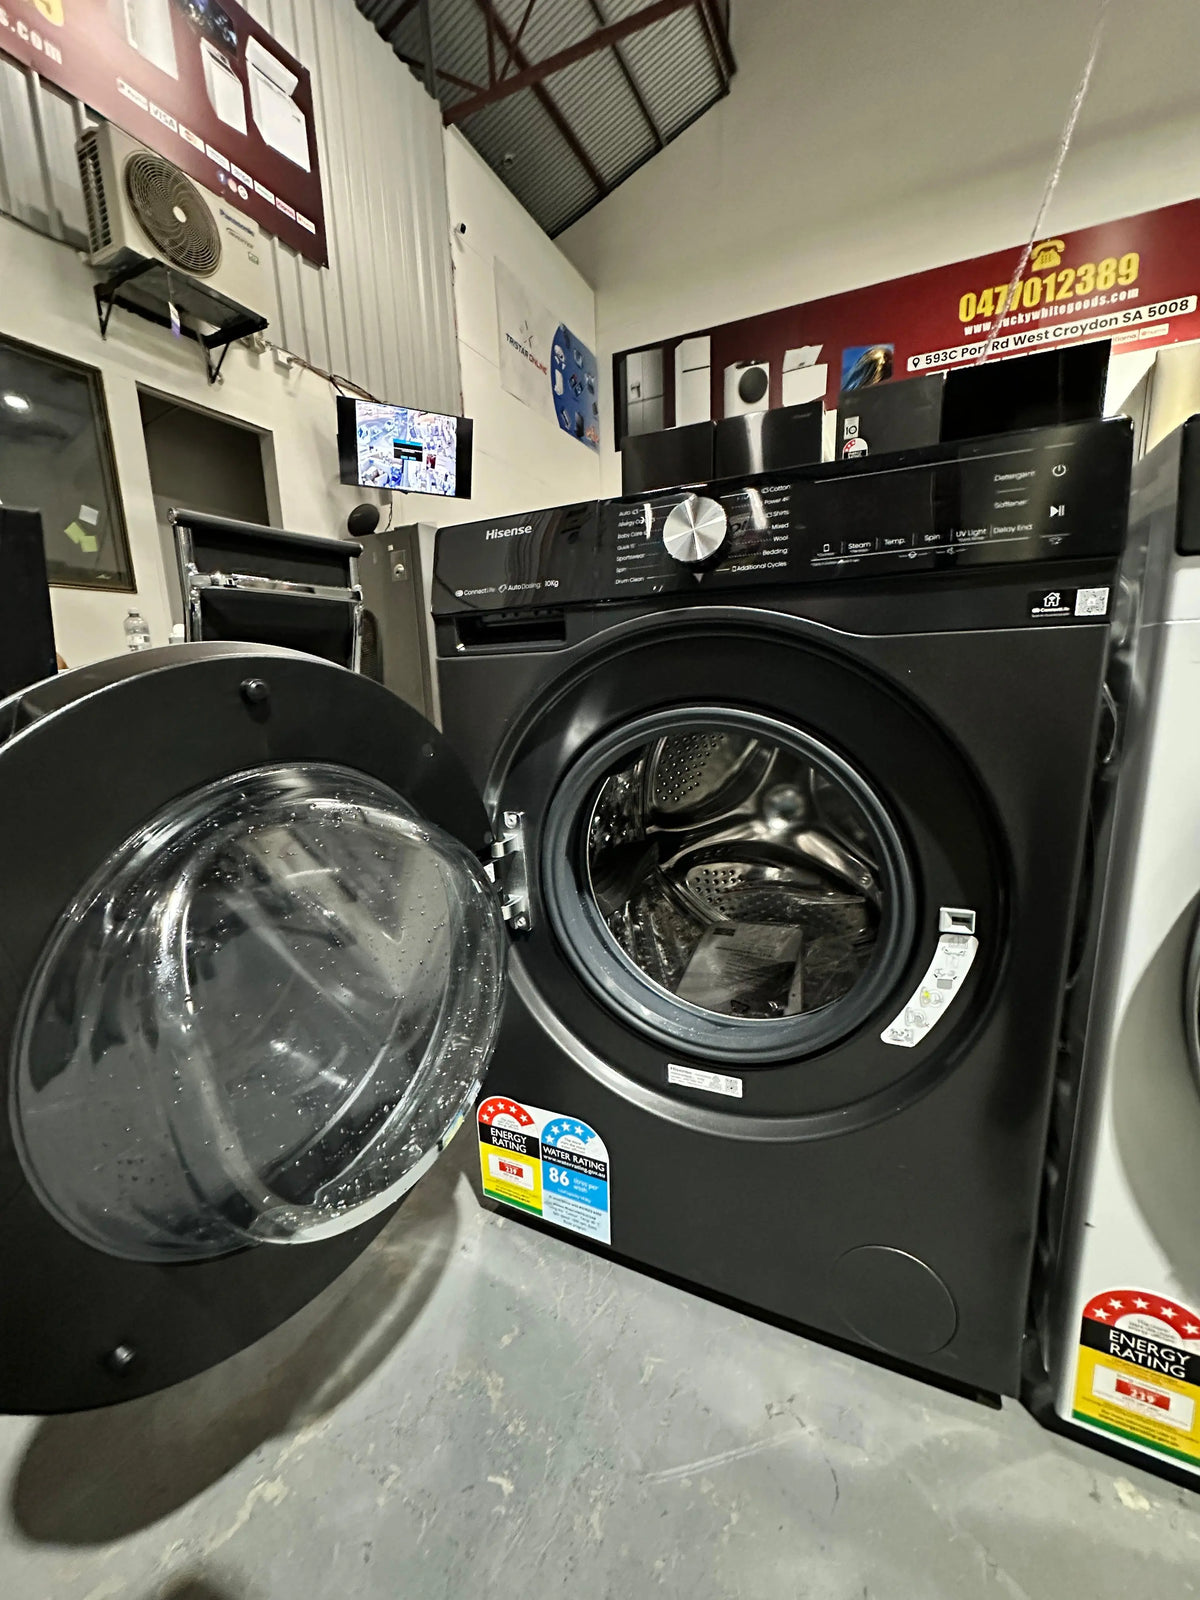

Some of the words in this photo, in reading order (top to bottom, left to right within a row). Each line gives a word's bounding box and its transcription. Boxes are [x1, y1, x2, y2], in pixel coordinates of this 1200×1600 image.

[958, 252, 1140, 323] 0477012389
[925, 349, 958, 365] 593C
[992, 338, 1009, 351] Rd
[1013, 330, 1049, 346] West
[1053, 316, 1118, 338] Croydon
[1122, 310, 1143, 323] SA
[1148, 299, 1189, 318] 5008
[506, 333, 529, 357] TRISTAR
[769, 484, 791, 493] Cotton
[486, 525, 532, 540] Hisense
[772, 522, 789, 530] Mixed
[955, 530, 967, 538] UV
[968, 528, 986, 536] Light
[993, 526, 1016, 534] Delay
[1017, 523, 1033, 531] End
[924, 533, 940, 541] Spin
[762, 548, 788, 556] Bedding
[848, 541, 871, 550] Steam
[737, 562, 766, 571] Additional
[767, 561, 787, 569] Cycles
[490, 1127, 527, 1144] ENERGY
[492, 1136, 527, 1154] RATING
[542, 1145, 571, 1161] WATER
[572, 1155, 605, 1172] RATING
[549, 1166, 570, 1187] 86
[1109, 1328, 1191, 1366] ENERGY
[1110, 1342, 1186, 1378] RATING
